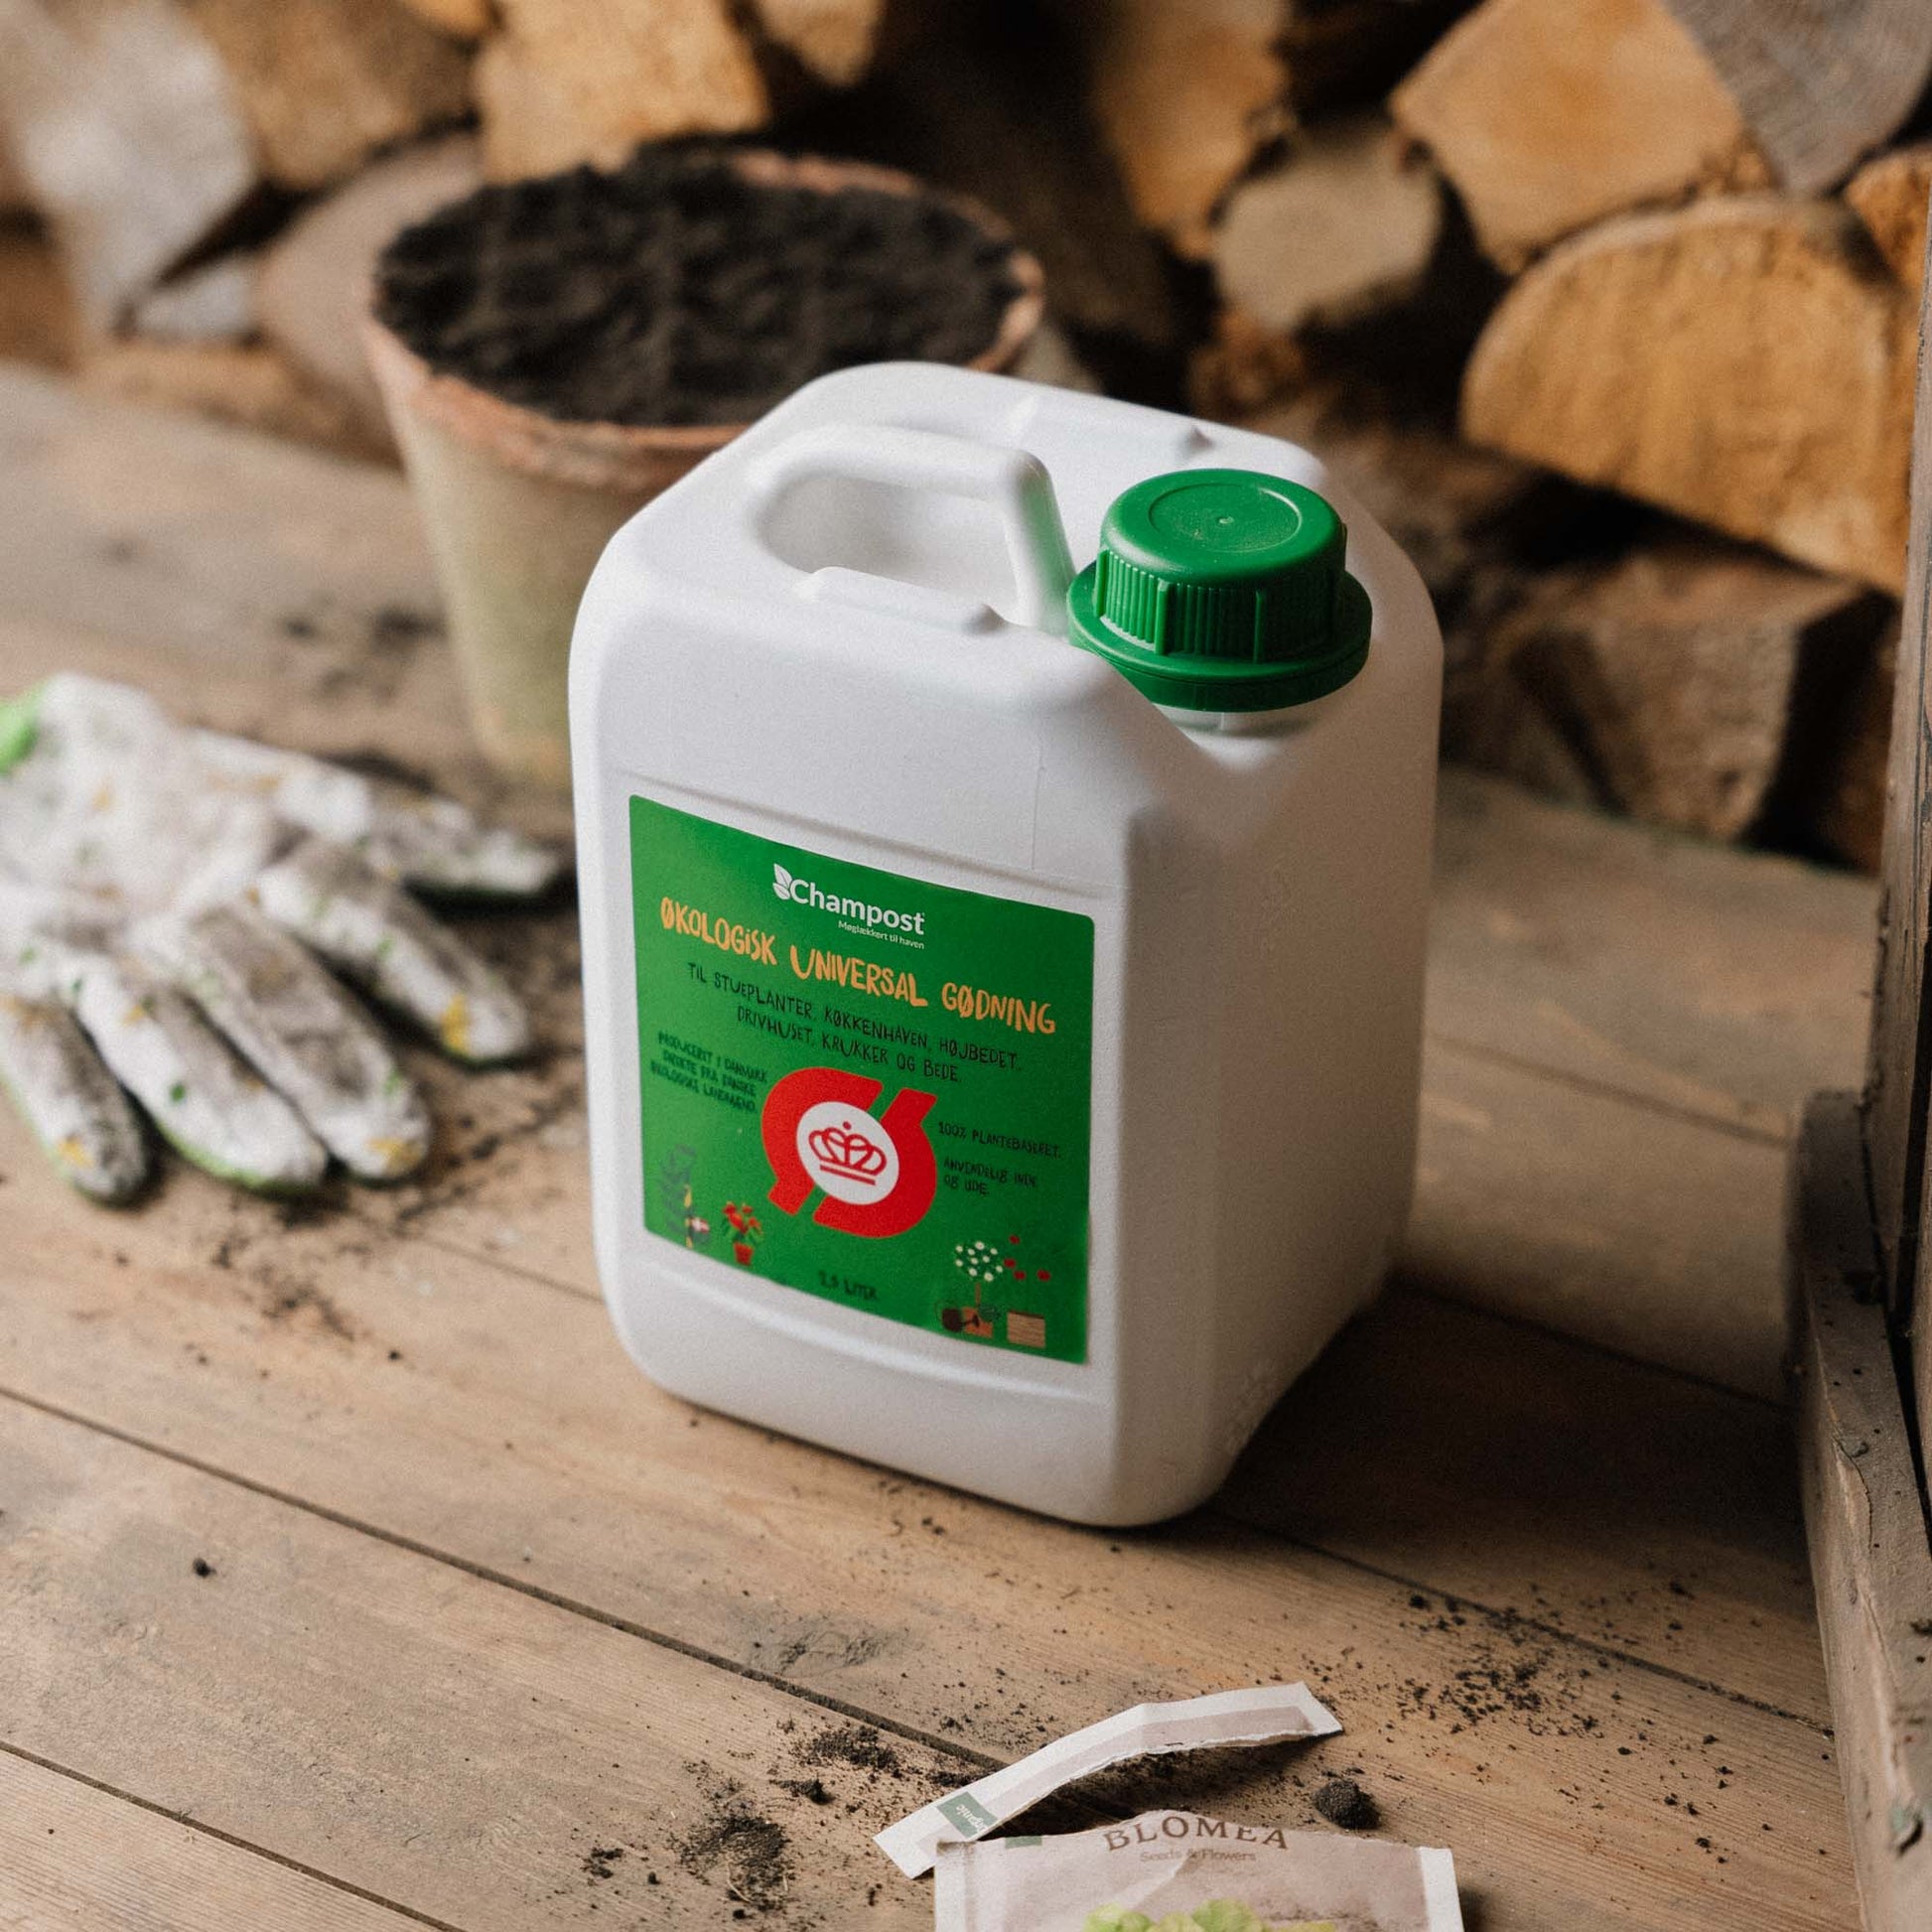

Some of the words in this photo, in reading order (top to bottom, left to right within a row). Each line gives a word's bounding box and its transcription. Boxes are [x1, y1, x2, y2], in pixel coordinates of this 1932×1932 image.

[789, 878, 924, 935] Champost
[889, 933, 898, 944] til
[899, 935, 924, 950] haven
[688, 962, 707, 983] TIL
[789, 945, 928, 1007] UNIVERSAL
[941, 982, 1056, 1034] GØDNING
[822, 1032, 888, 1065] KRUKKER
[897, 1052, 915, 1072] OG
[1102, 1815, 1290, 1852] BLOMEA
[1141, 1850, 1182, 1863] Seeds
[1197, 1848, 1257, 1863] Flowers
